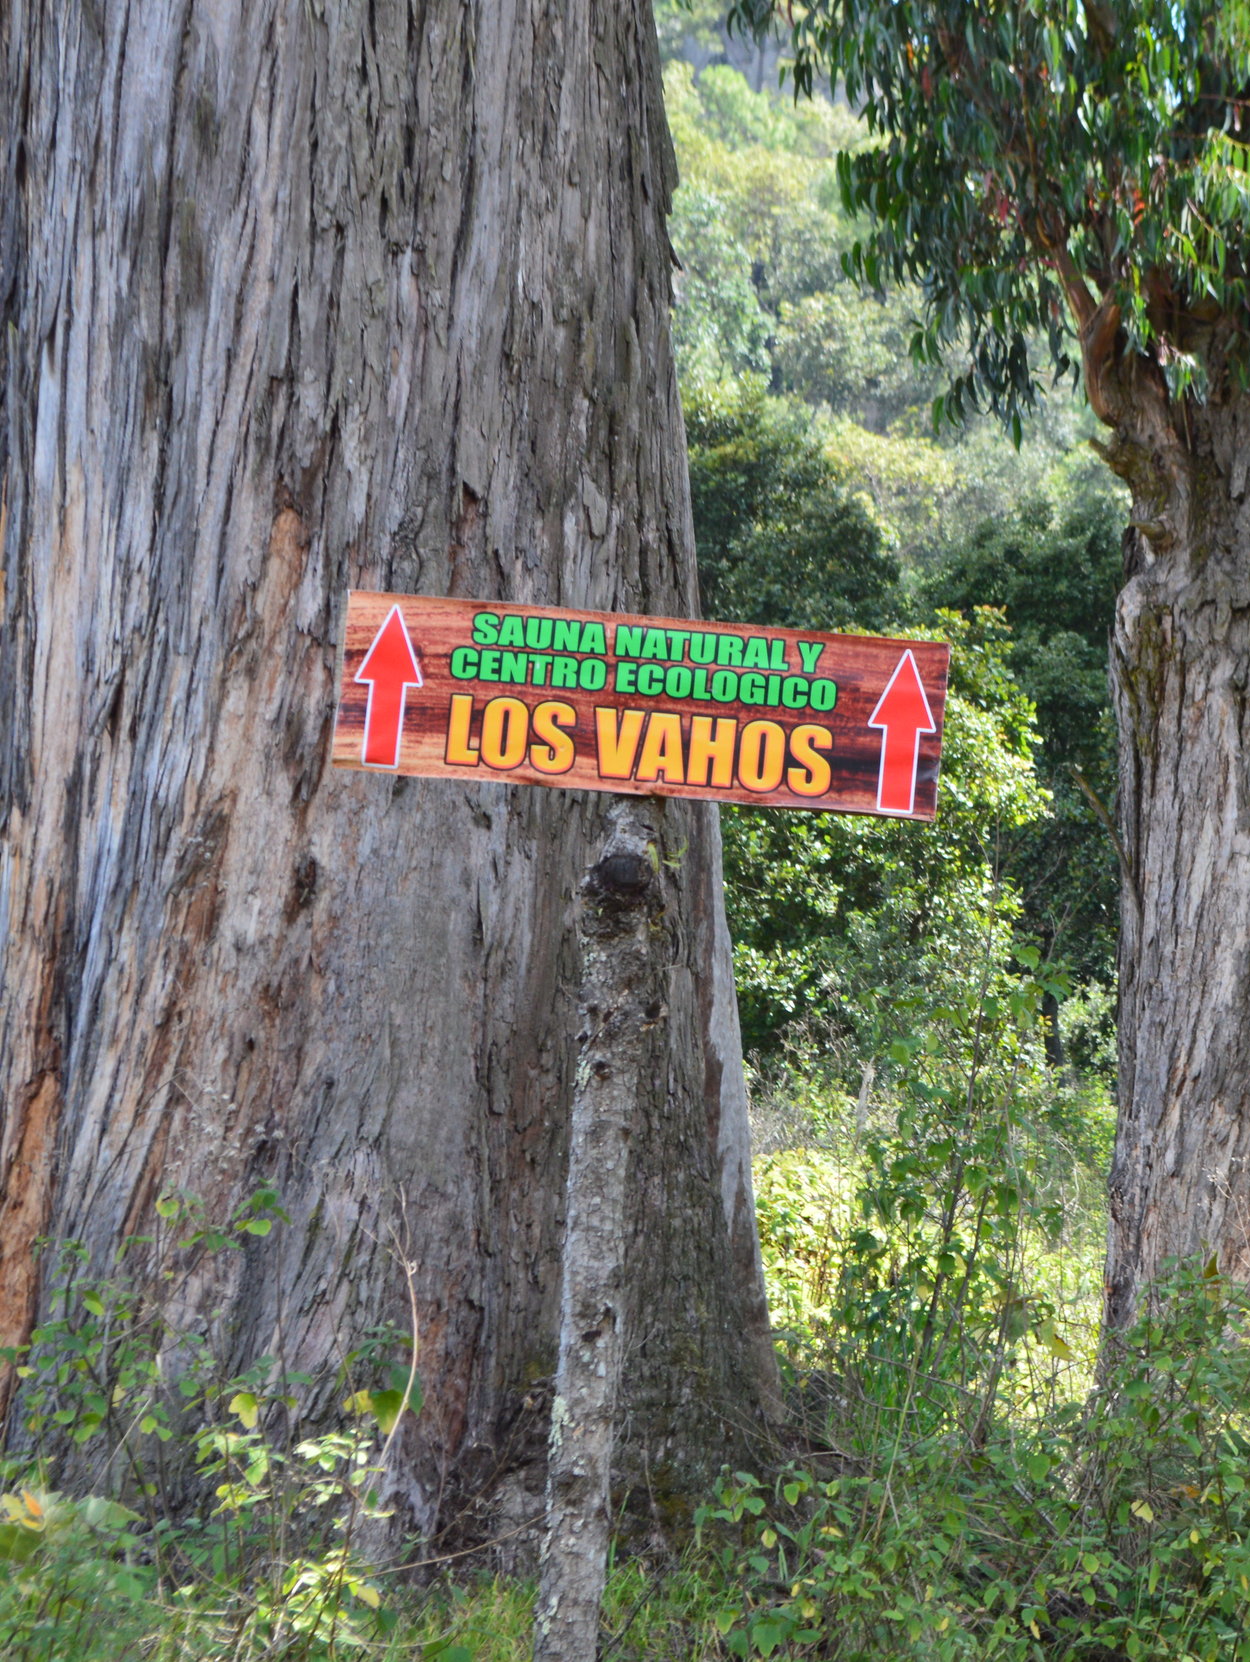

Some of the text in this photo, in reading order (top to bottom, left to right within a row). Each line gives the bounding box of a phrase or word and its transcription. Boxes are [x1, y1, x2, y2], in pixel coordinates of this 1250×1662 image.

[472, 612, 826, 674] SAUNA NATURAL Y
[450, 647, 837, 711] CENTRO ECOLOGICO
[445, 694, 834, 797] LOS VAHOS
